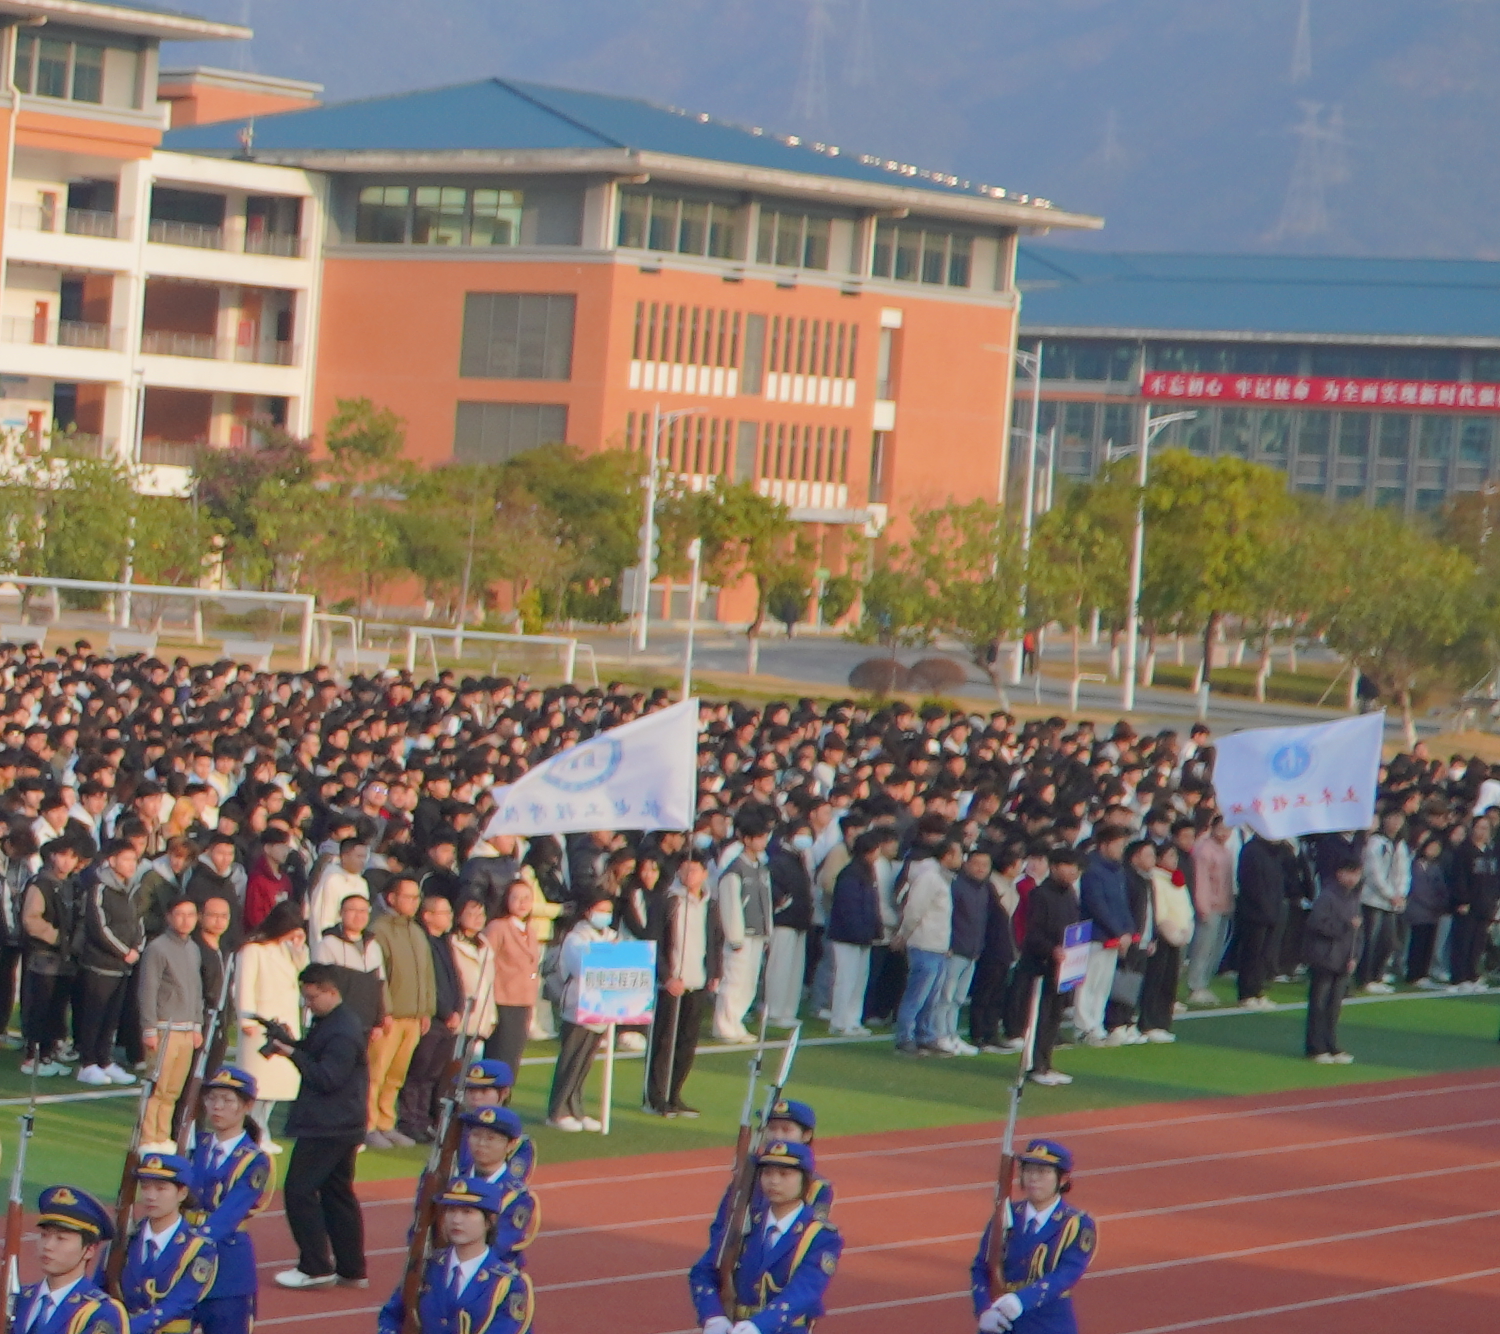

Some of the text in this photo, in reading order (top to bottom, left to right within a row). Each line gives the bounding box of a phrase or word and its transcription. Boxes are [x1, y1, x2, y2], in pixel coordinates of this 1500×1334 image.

[1150, 374, 1224, 396] 不忘初心
[1235, 376, 1311, 401] 牢记使命
